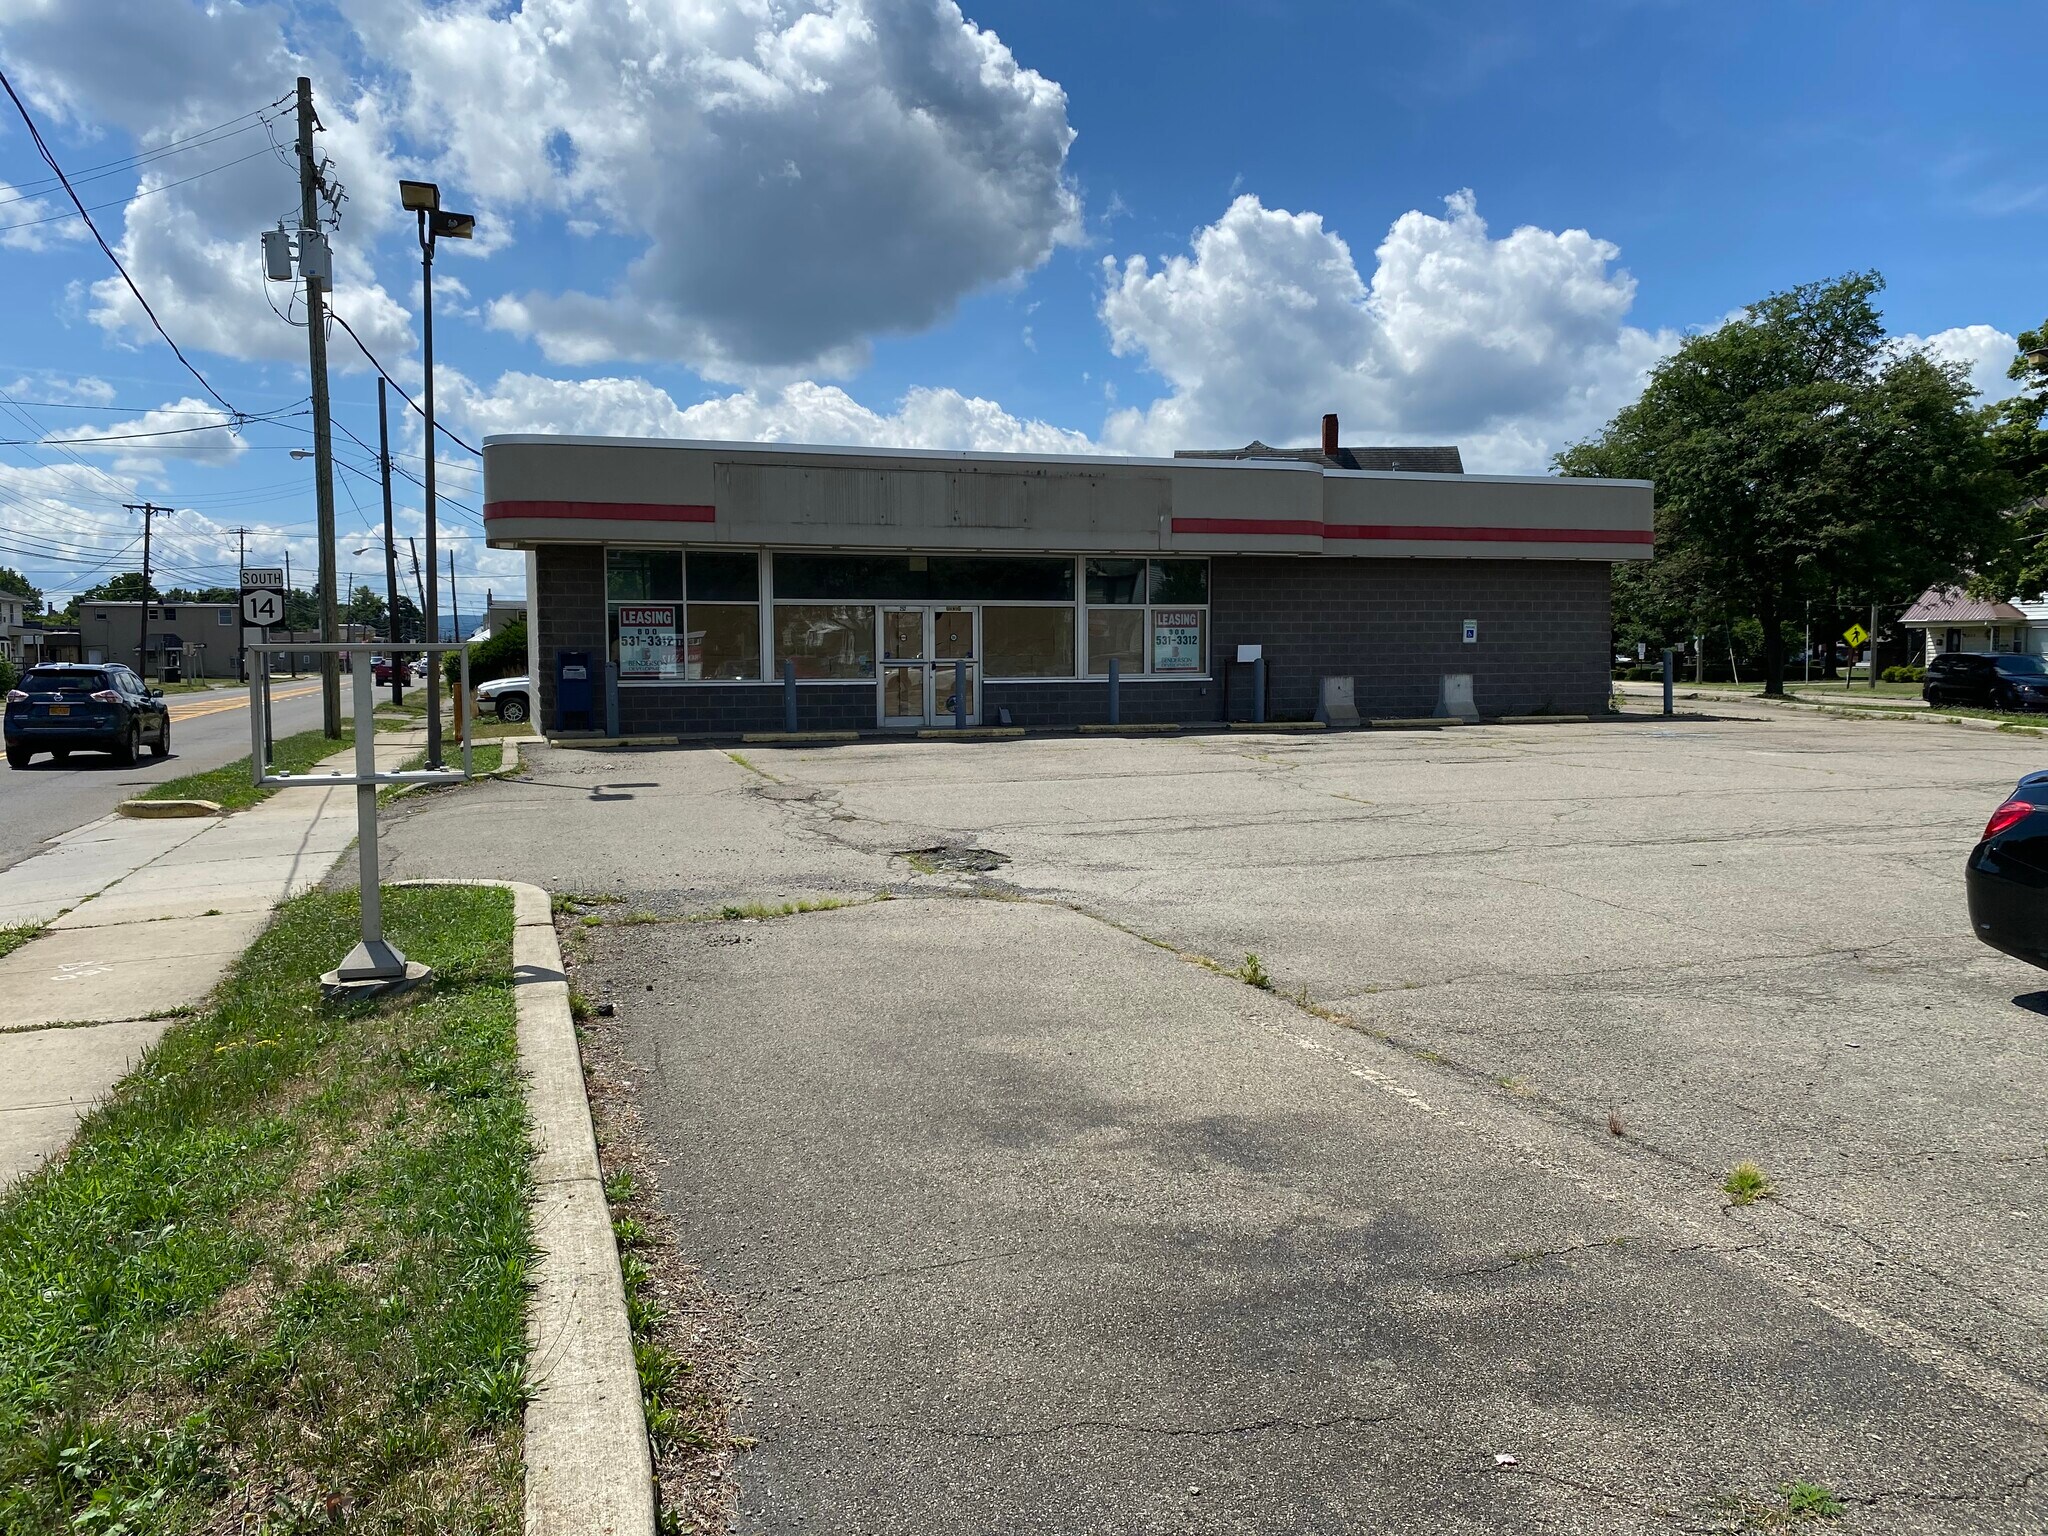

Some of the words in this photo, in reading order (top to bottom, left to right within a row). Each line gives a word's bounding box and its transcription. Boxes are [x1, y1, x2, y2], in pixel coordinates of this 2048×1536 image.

[242, 572, 281, 584] SOUTH
[250, 597, 275, 619] 14
[622, 610, 672, 624] LEASING
[1157, 613, 1196, 625] LEASING
[1156, 635, 1198, 646] 531-3312
